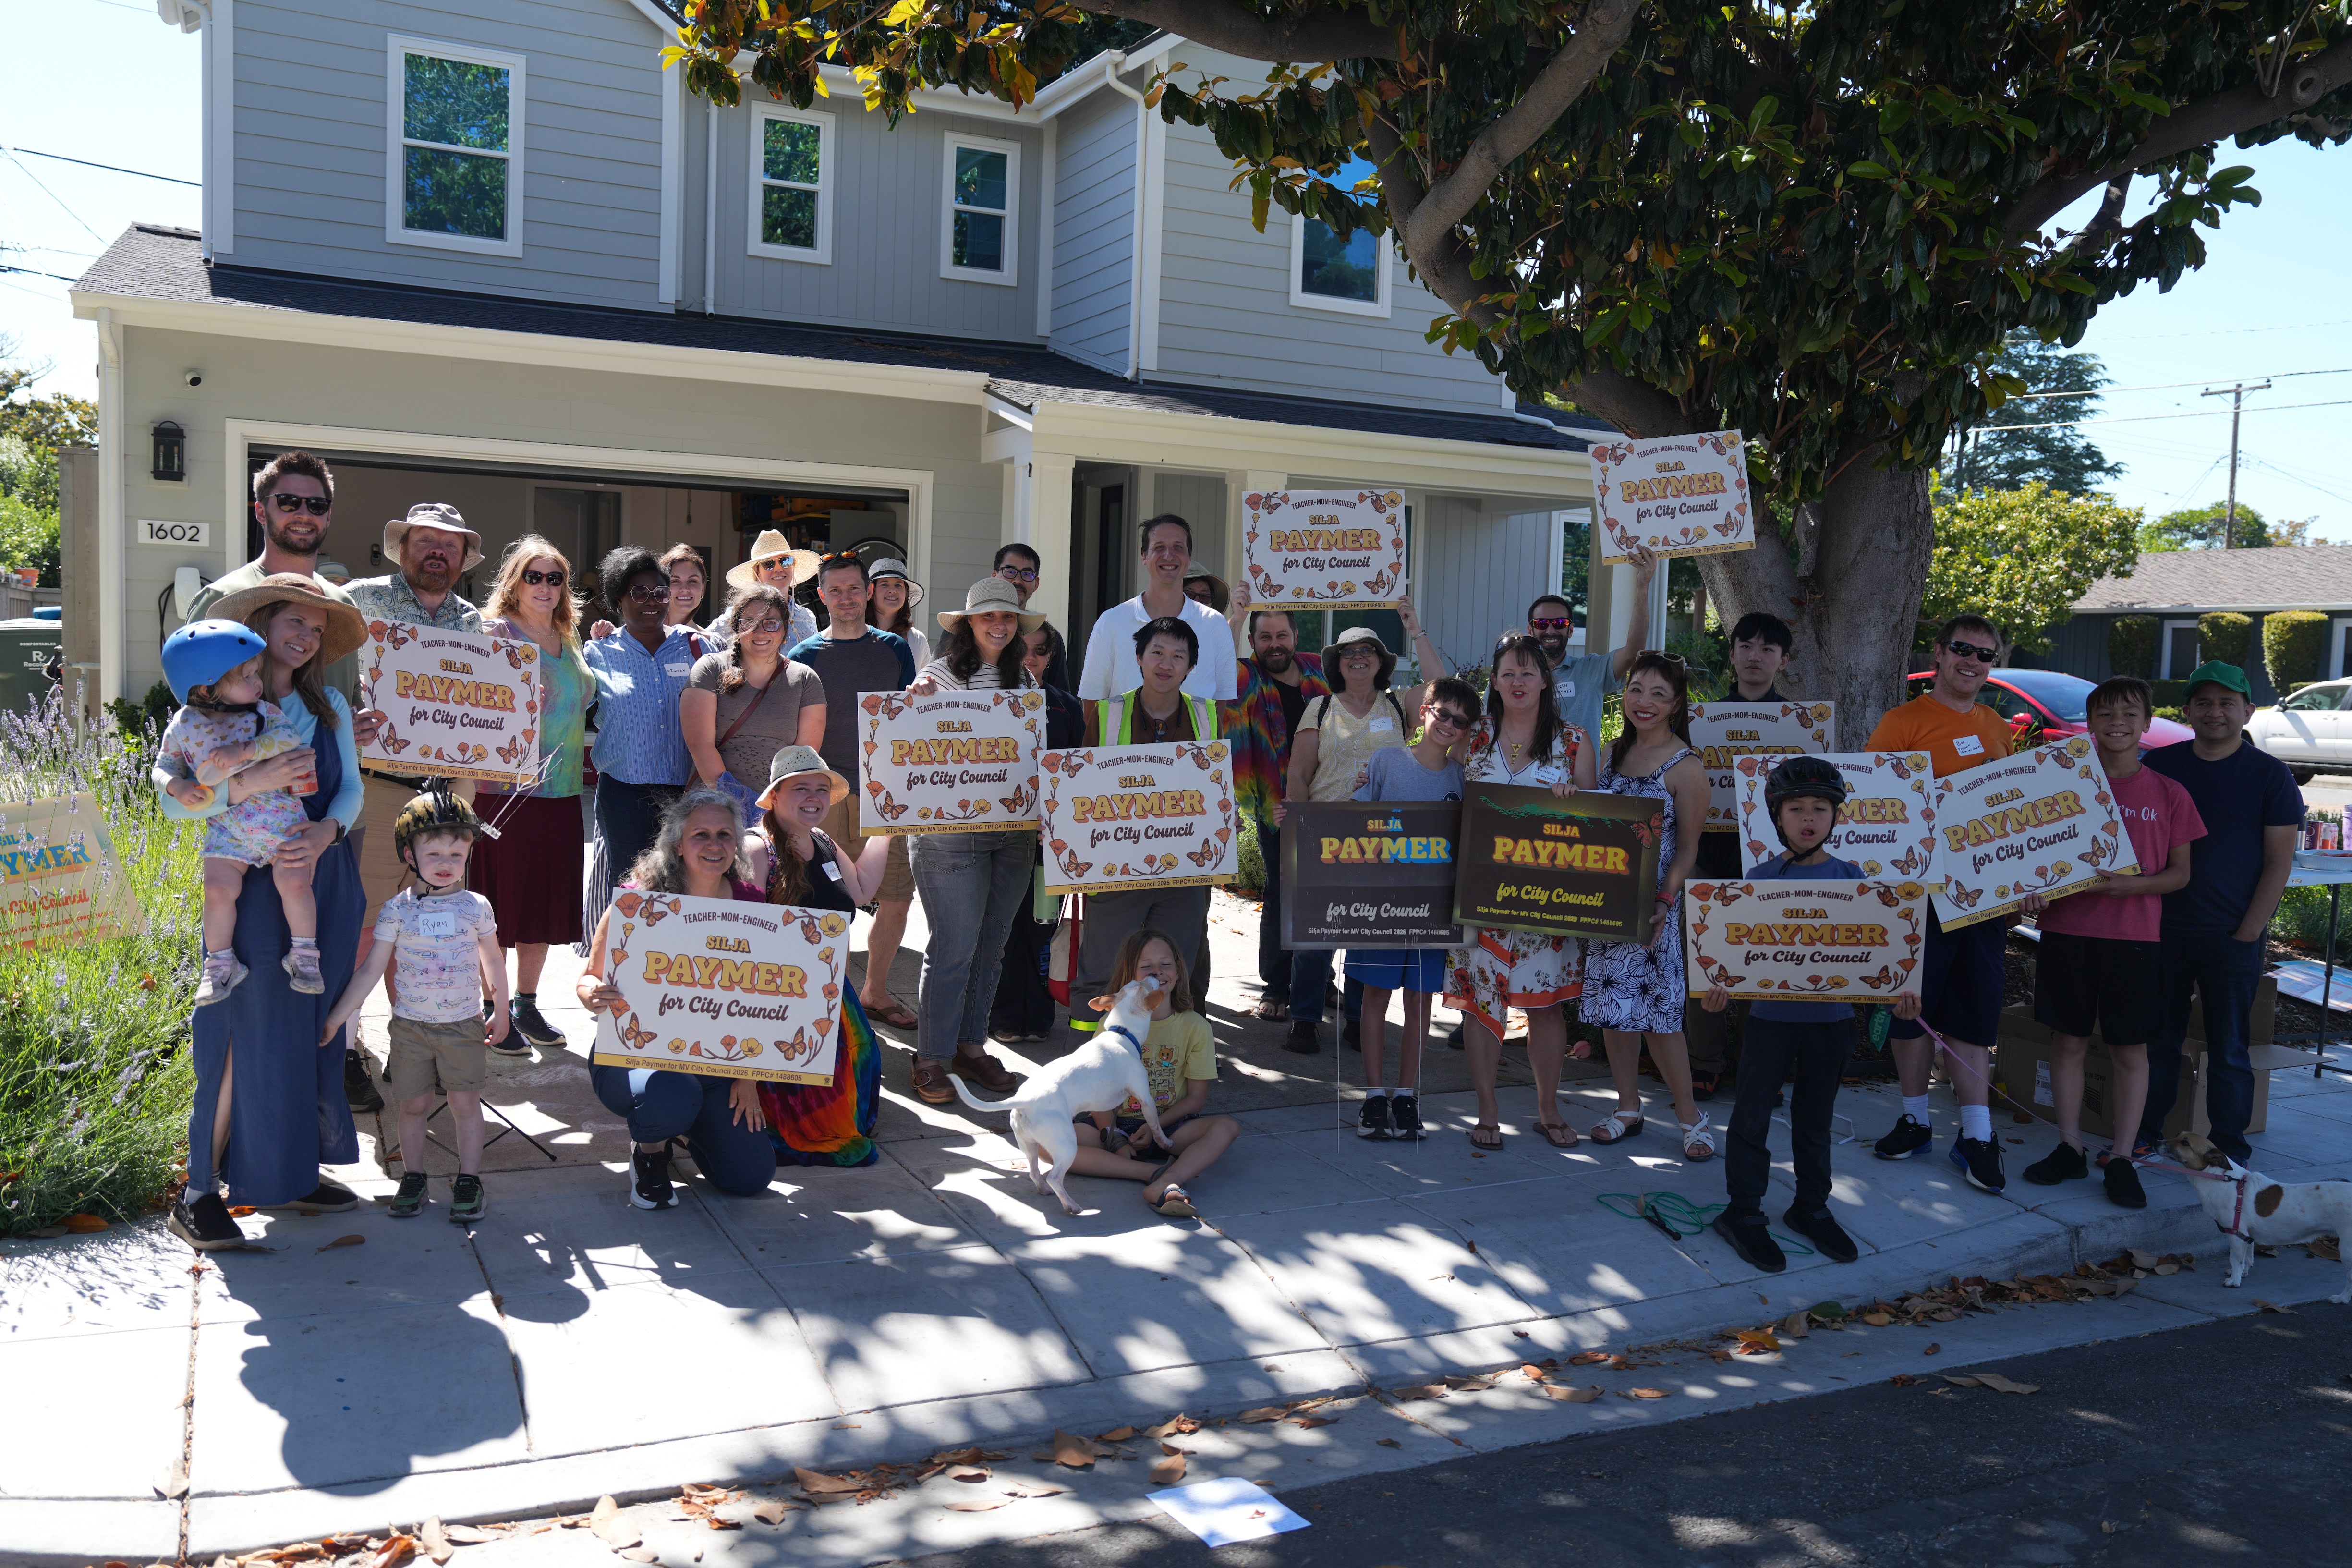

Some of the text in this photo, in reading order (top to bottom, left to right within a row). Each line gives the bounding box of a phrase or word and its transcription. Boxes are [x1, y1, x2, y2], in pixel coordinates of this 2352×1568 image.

[1637, 445, 1697, 459] TEACHER-MOM-ENGINEER
[1655, 461, 1685, 473] SILJA
[1620, 472, 1727, 503] PAYMER
[1291, 498, 1356, 510] TEACHER-MOM-ENGINEER
[1637, 499, 1719, 524] for City Council
[1309, 515, 1340, 525] SILJA
[147, 523, 199, 542] 1602
[1270, 529, 1382, 552] PAYMER
[1283, 556, 1370, 573] for City Council
[421, 640, 490, 659] TEACHER-MOM-ENGINEER
[440, 659, 473, 675] SILJA
[395, 670, 516, 713] PAYMER
[916, 701, 991, 714] TEACHER-MOM-ENGINEER
[410, 706, 504, 731] for City Council
[937, 720, 972, 733] SILJA
[1706, 712, 1779, 723] TEACHER-MOM-ENGINEER
[1726, 730, 1760, 741] SILJA
[891, 737, 1020, 766] PAYMER
[1096, 755, 1174, 770] TEACHER-MOM-ENGINEER
[1831, 763, 1873, 776] OM-ENGINEER
[907, 769, 1007, 791] for City Council
[1119, 775, 1156, 788] SILJA
[1957, 766, 2036, 796] TEACHER-MOM-ENGINEER
[1072, 790, 1207, 823] PAYMER
[1984, 787, 2025, 807] SILJA
[1838, 798, 1909, 825] MER
[2141, 807, 2158, 821] Ok
[1367, 818, 1403, 832] SILJA
[1543, 823, 1580, 838] SILJA
[1943, 790, 2086, 853] PAYMER
[0, 832, 35, 846] SILA
[1090, 822, 1194, 848] for City Council
[1845, 829, 1897, 845] Council
[1321, 837, 1452, 863] PAYMER
[1492, 836, 1630, 875] PAYMER
[1973, 823, 2079, 874] for City Council
[0, 842, 92, 876] YMER
[9, 899, 37, 917] City
[40, 889, 89, 910] Council
[1496, 882, 1604, 907] for City Council
[1757, 890, 1854, 902] TEACHER-MOM-ENGINEER
[1980, 909, 2000, 918] Paymer
[2055, 887, 2069, 896] 2026
[2071, 881, 2090, 891] FPPC#
[1326, 902, 1430, 922] for City Council
[1782, 908, 1828, 919] SILJA
[422, 918, 448, 933] Ryan
[683, 912, 778, 933] TEACHER-MOM-ENGINEER
[705, 935, 751, 954] SILJA
[1725, 923, 1889, 947] PAYMER
[1745, 950, 1871, 966] for City Council
[643, 951, 807, 999] PAYMER
[658, 993, 789, 1021] for City Council
[626, 1058, 640, 1066] Silja
[642, 1060, 667, 1068] Paymer
[691, 1065, 704, 1073] City
[706, 1066, 731, 1074] Council
[776, 1073, 802, 1081] 1488605
[1149, 1078, 1175, 1090] ETHER
